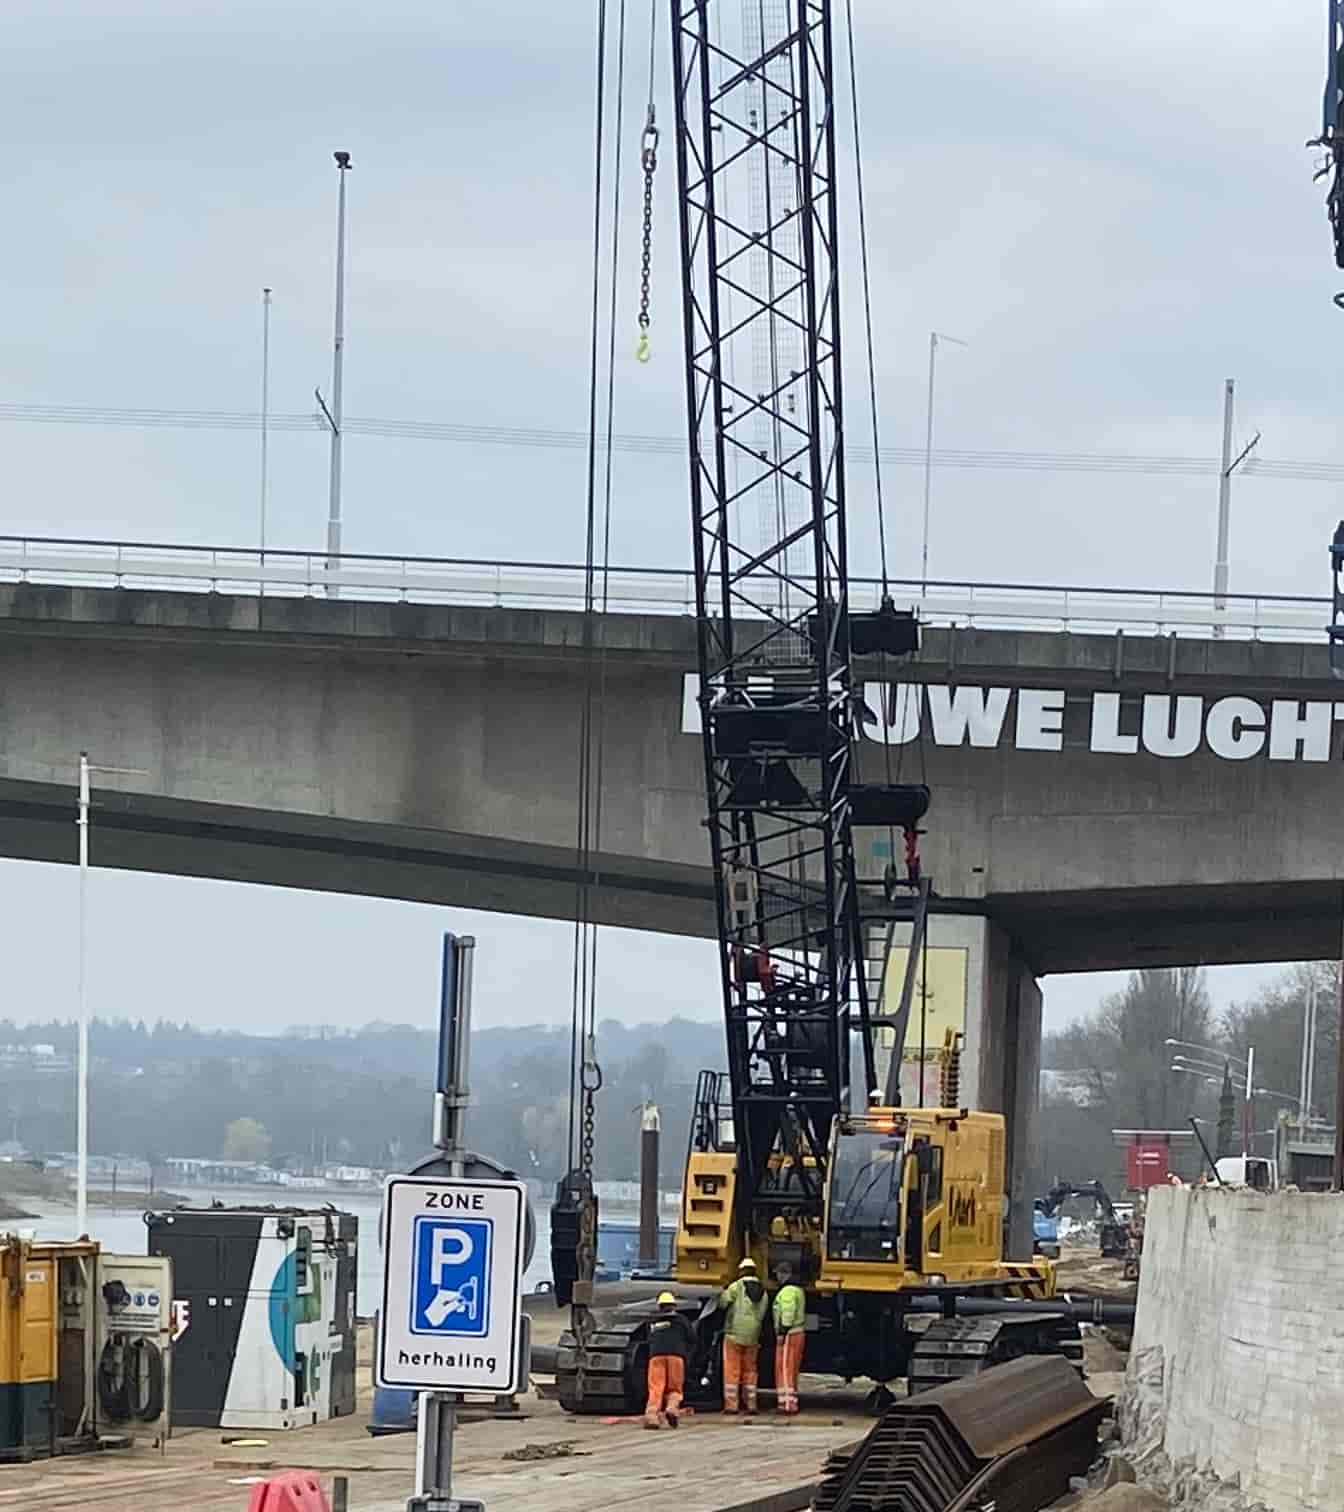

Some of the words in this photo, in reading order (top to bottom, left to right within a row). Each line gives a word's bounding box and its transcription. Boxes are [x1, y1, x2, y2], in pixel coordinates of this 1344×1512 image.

[425, 1192, 485, 1211] ZONE
[431, 1227, 474, 1285] P
[398, 1349, 497, 1373] herhaling
